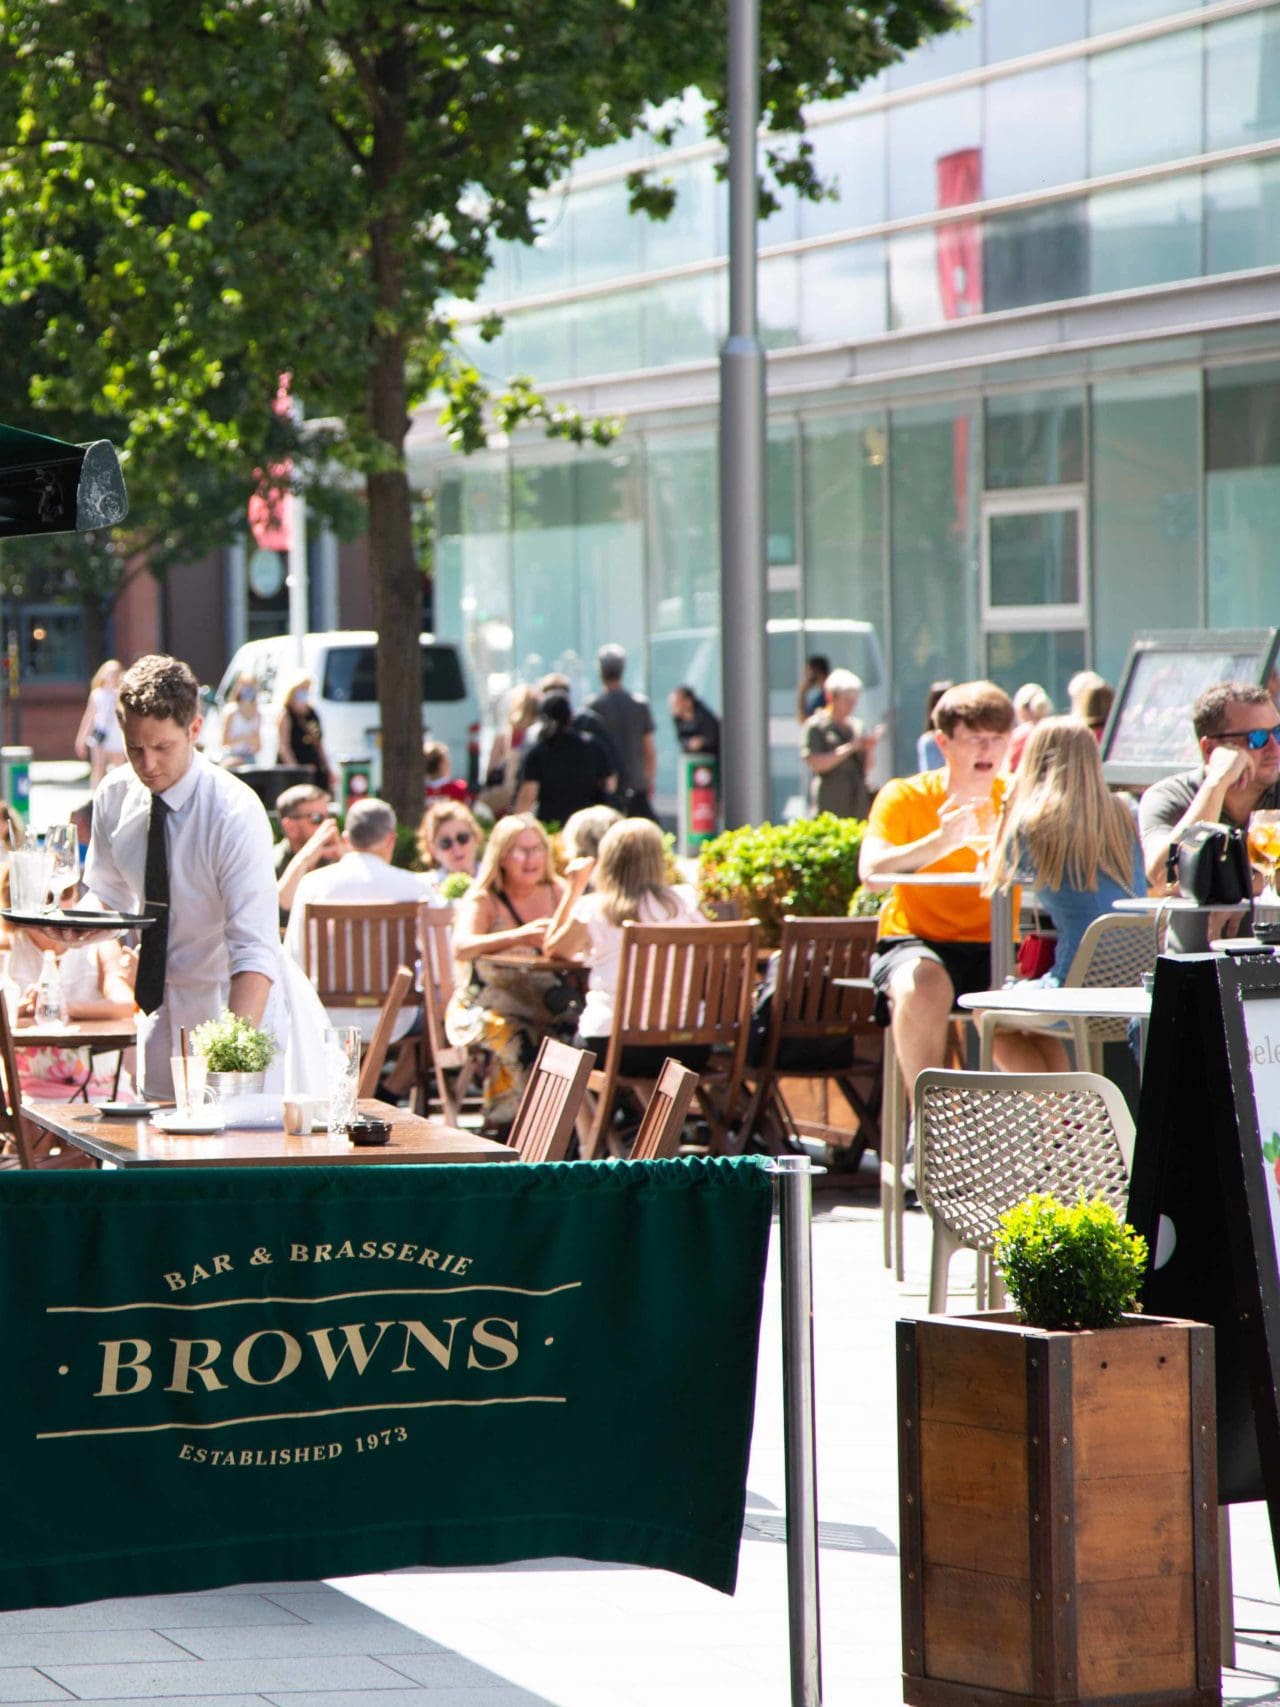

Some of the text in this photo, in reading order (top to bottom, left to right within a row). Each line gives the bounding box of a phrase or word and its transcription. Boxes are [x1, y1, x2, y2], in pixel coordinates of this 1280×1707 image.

[163, 1240, 473, 1291] BAR & BRASSERIE
[93, 1317, 520, 1397] BROWNS
[178, 1426, 408, 1466] ESTABLISHED 1973
